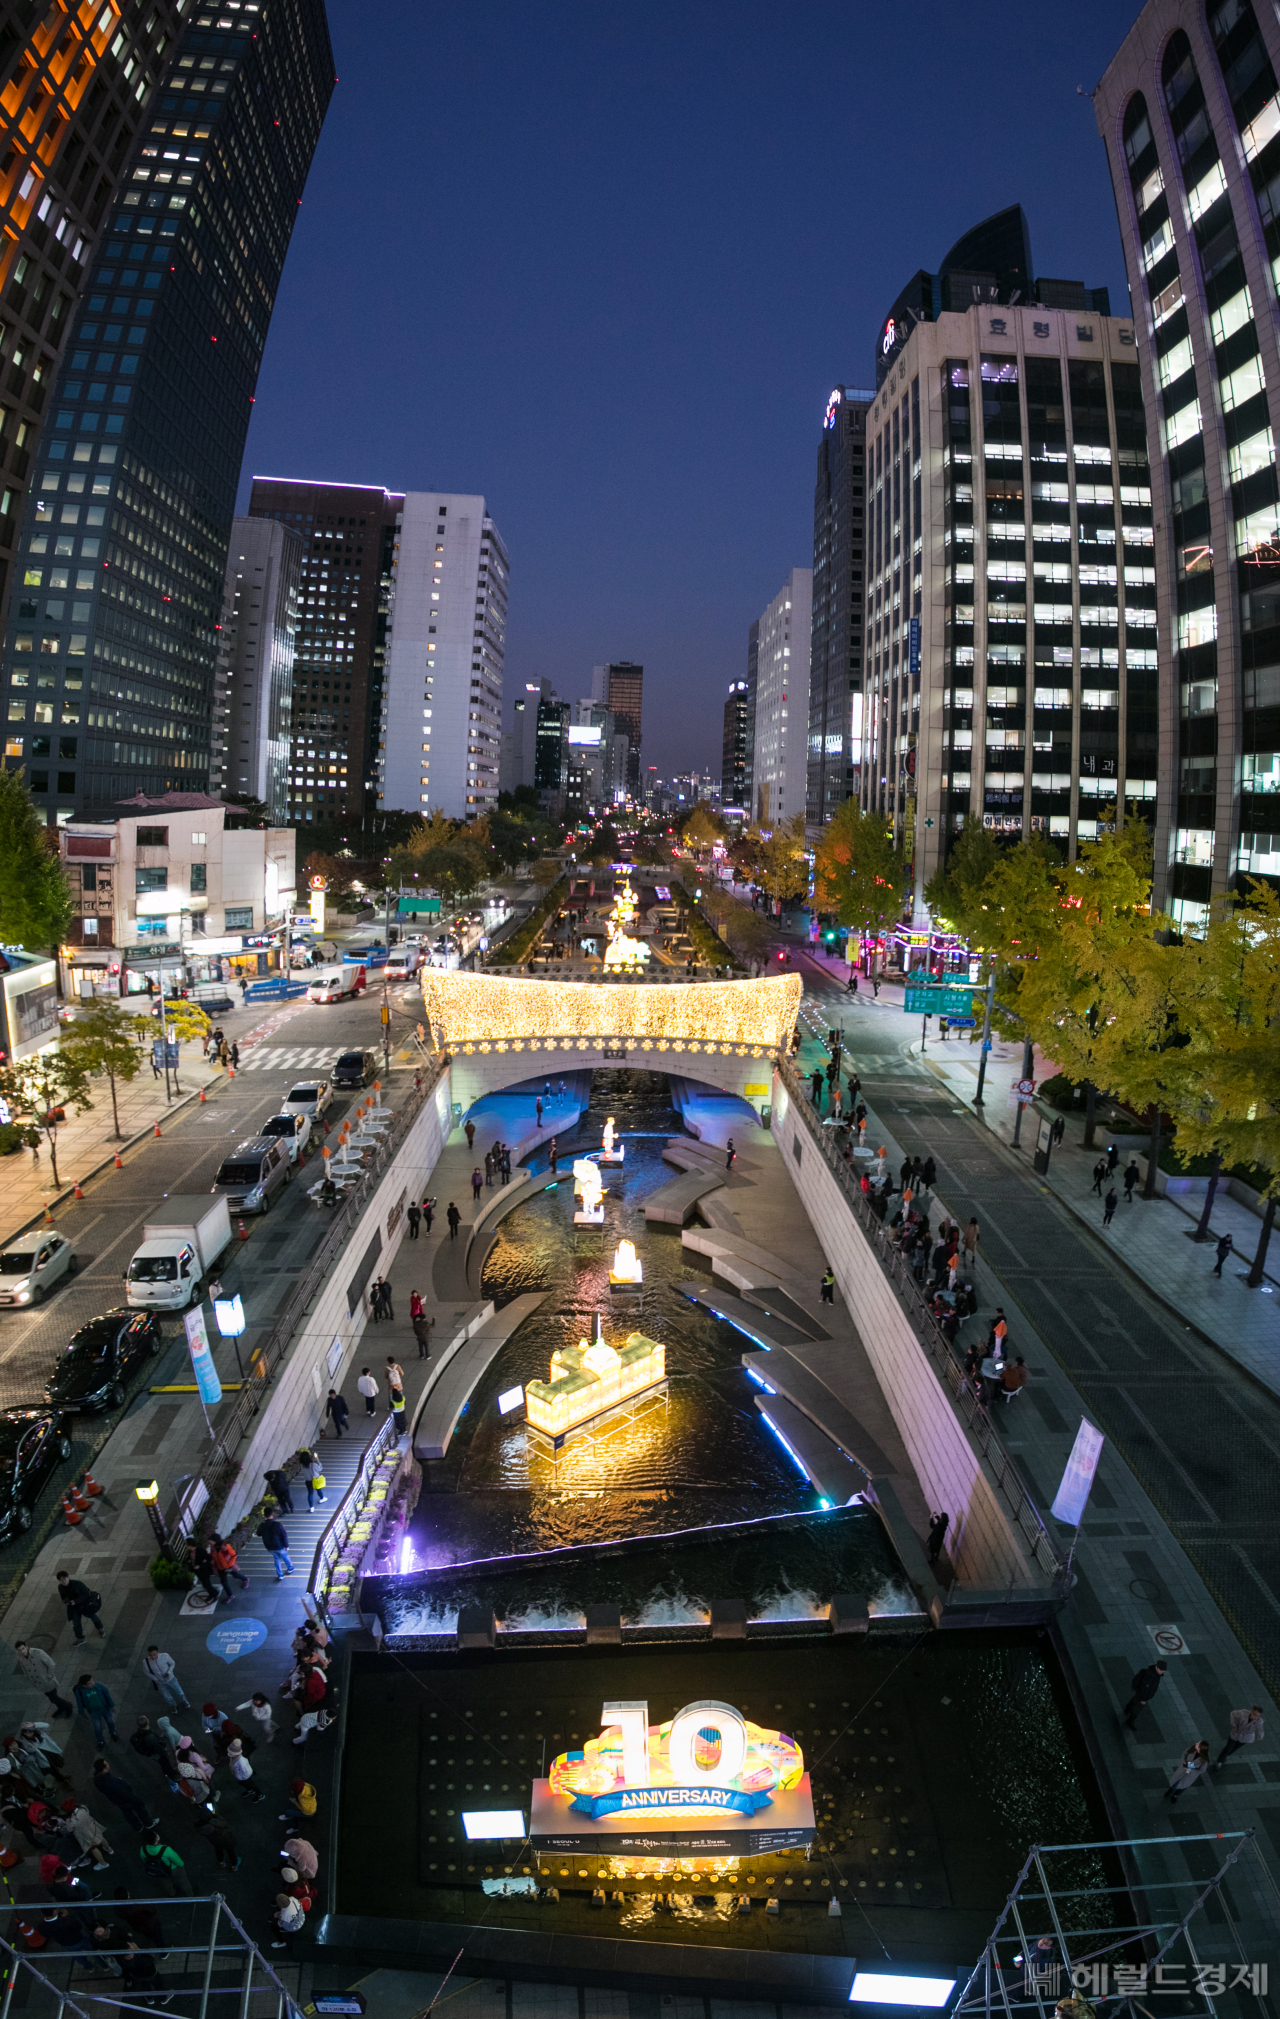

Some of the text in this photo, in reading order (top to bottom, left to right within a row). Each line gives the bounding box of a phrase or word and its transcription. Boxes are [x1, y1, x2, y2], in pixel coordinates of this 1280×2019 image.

[882, 320, 895, 355] citi
[989, 317, 1135, 346] 효령빌딩
[1082, 755, 1115, 775] 내과
[600, 1700, 748, 1788] 10
[620, 1789, 732, 1808] ANNIVERSARY
